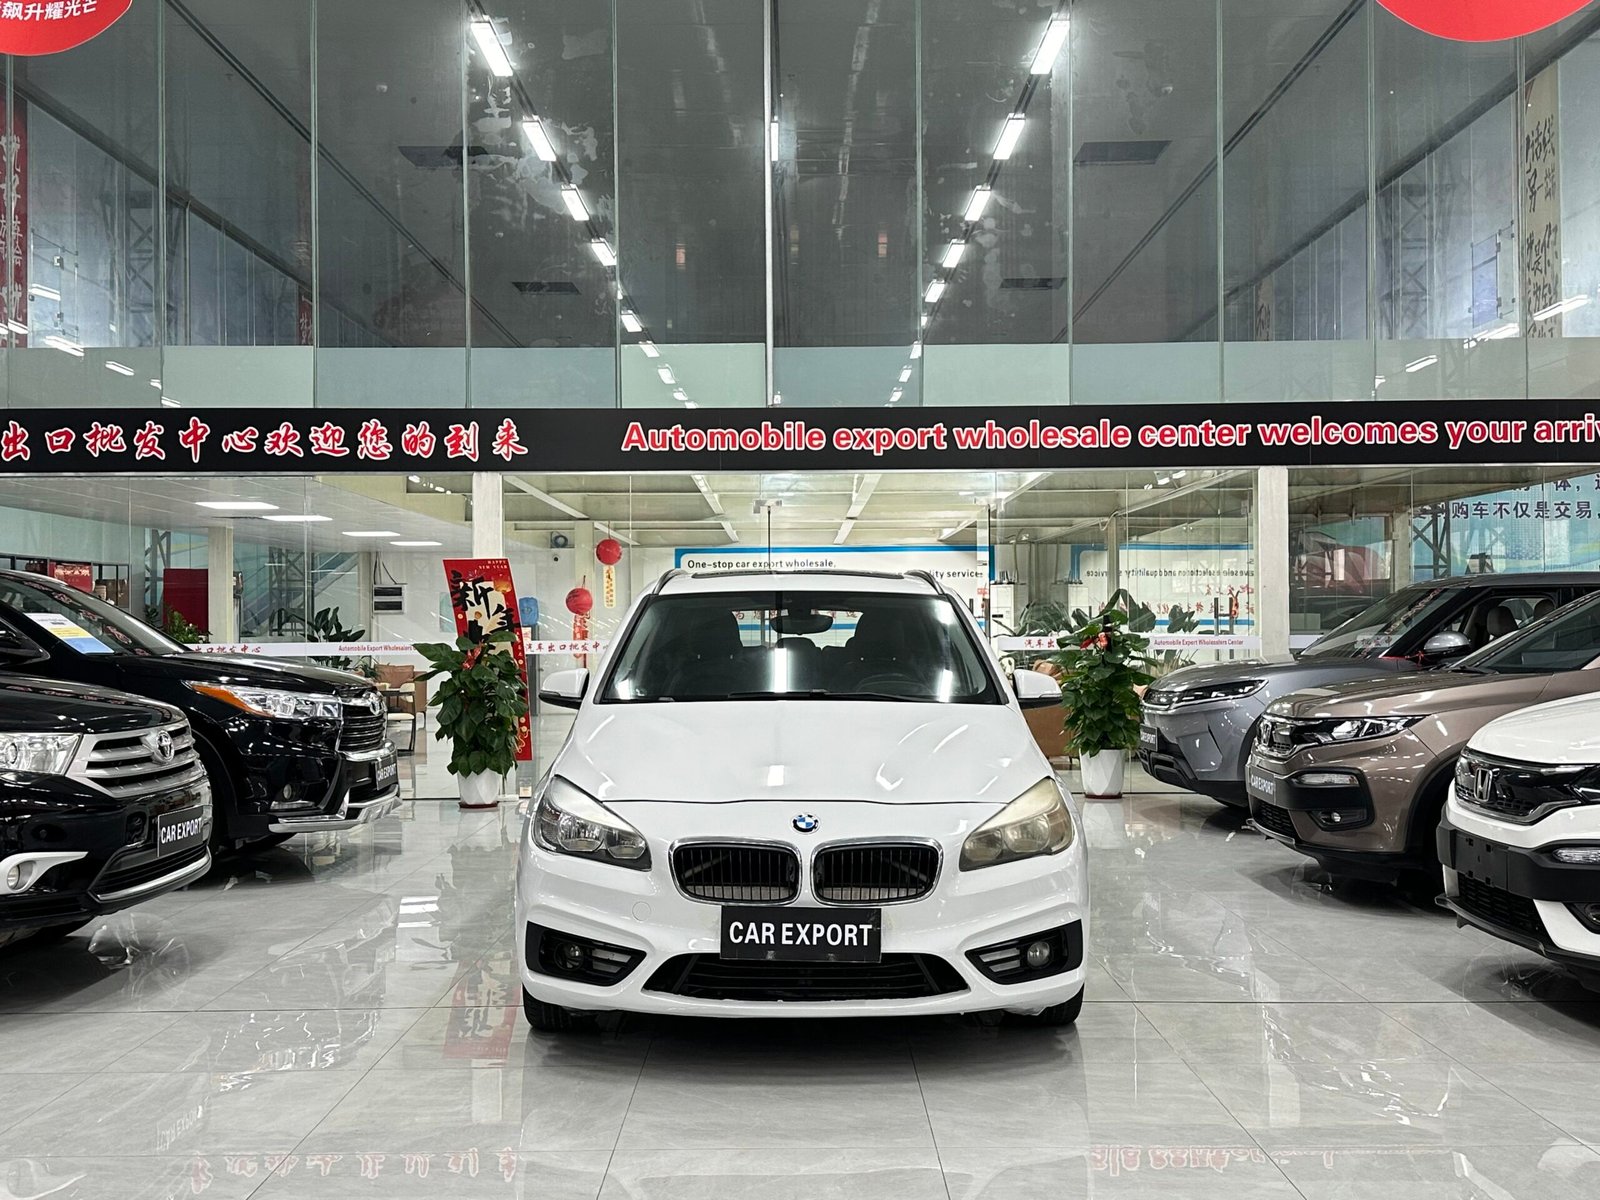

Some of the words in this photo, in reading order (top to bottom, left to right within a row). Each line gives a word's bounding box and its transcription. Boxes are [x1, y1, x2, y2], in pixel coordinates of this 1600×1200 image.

[0, 0, 98, 21] 飙升耀光芒
[0, 416, 529, 463] 出口批发中心欢迎您的到来
[621, 421, 827, 452] Automobile
[833, 423, 948, 456] export
[953, 418, 1132, 450] wholesale
[1138, 419, 1252, 448] center
[1257, 415, 1438, 446] welcomes
[1444, 417, 1527, 450] your
[1533, 413, 1600, 443] arri
[687, 559, 734, 569] One-stop
[735, 561, 750, 569] car
[160, 824, 177, 844] CAR
[177, 817, 202, 840] EXPORT
[728, 921, 776, 944] CAR
[781, 923, 873, 947] EXPORT
